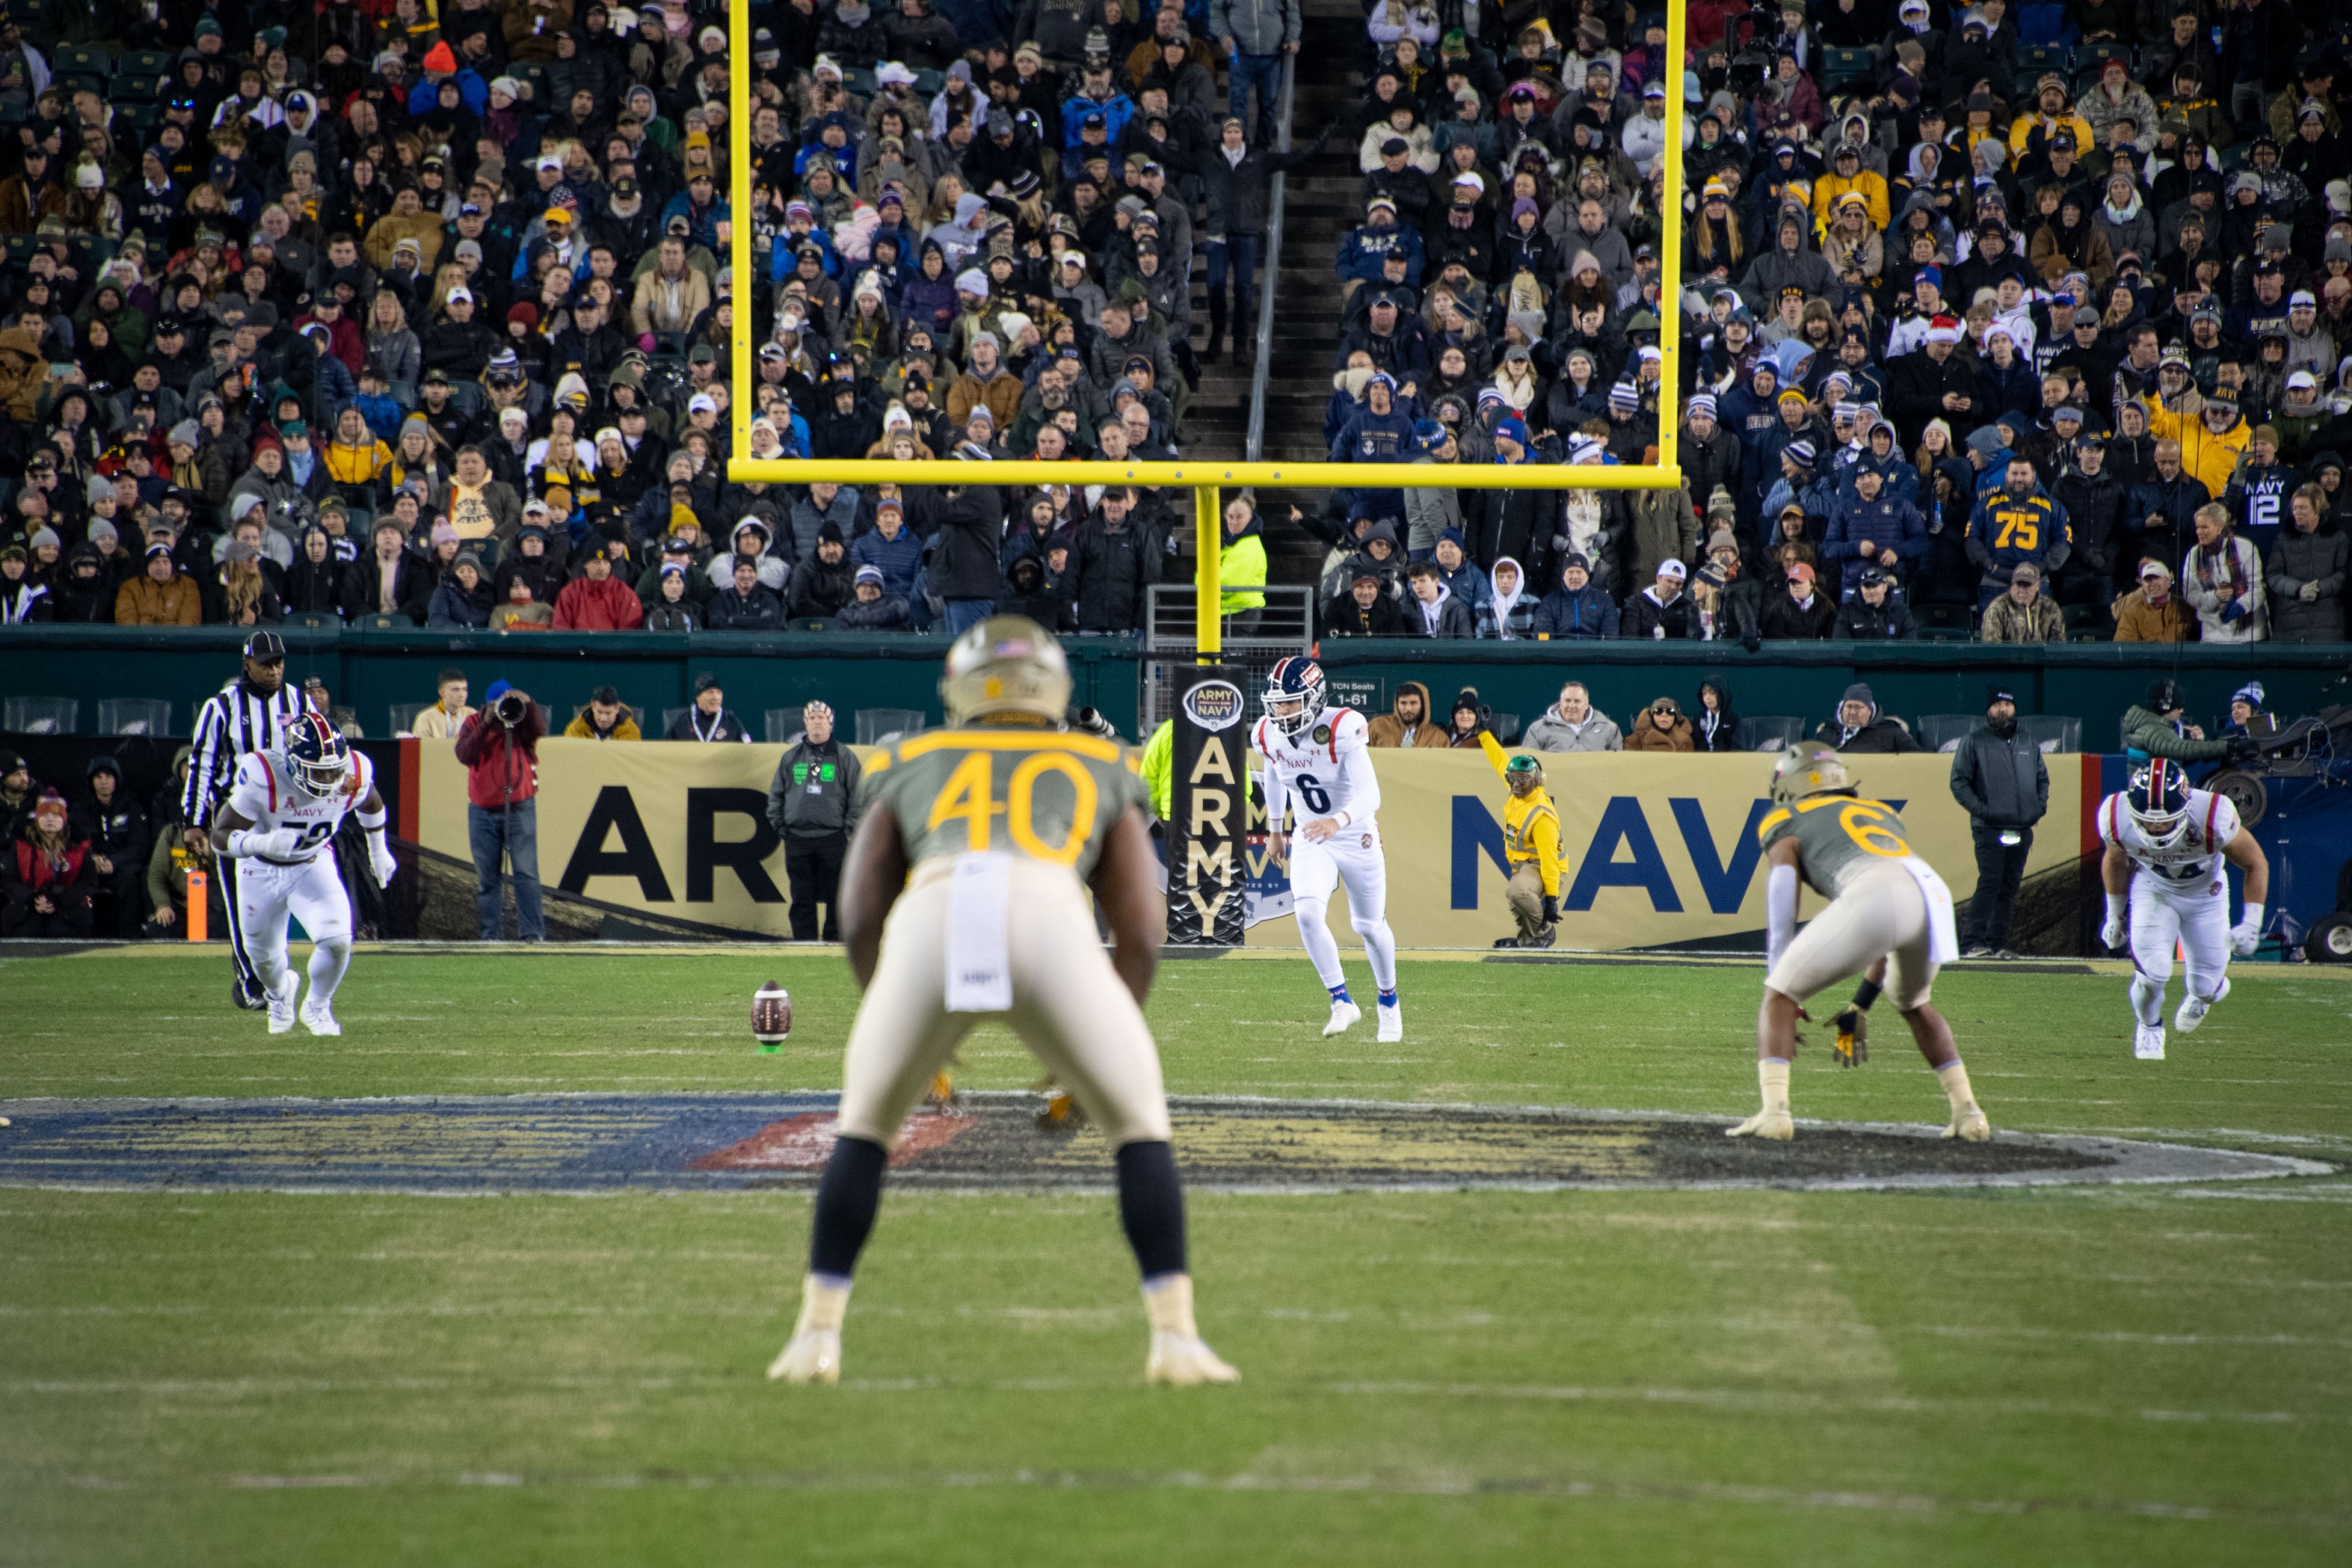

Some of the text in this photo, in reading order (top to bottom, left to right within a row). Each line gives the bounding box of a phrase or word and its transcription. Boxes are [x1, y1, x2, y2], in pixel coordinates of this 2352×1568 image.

[2036, 346, 2062, 357] NAVY
[2214, 385, 2238, 401] NAVY
[2245, 480, 2285, 495] NAVY
[2250, 494, 2281, 526] 12
[1994, 511, 2040, 550] 75
[1352, 682, 1375, 691] Seats
[1197, 689, 1233, 701] ARMY
[1337, 693, 1367, 706] 1-61
[1198, 706, 1233, 716] NAVY
[242, 714, 250, 725] S
[1287, 759, 1314, 769] NAVY
[1296, 773, 1331, 814] 6
[293, 807, 325, 817] NAVY
[926, 750, 1098, 864] 40
[1186, 736, 1236, 938] ARMY
[1842, 804, 1918, 859] 6
[558, 786, 785, 902] AR
